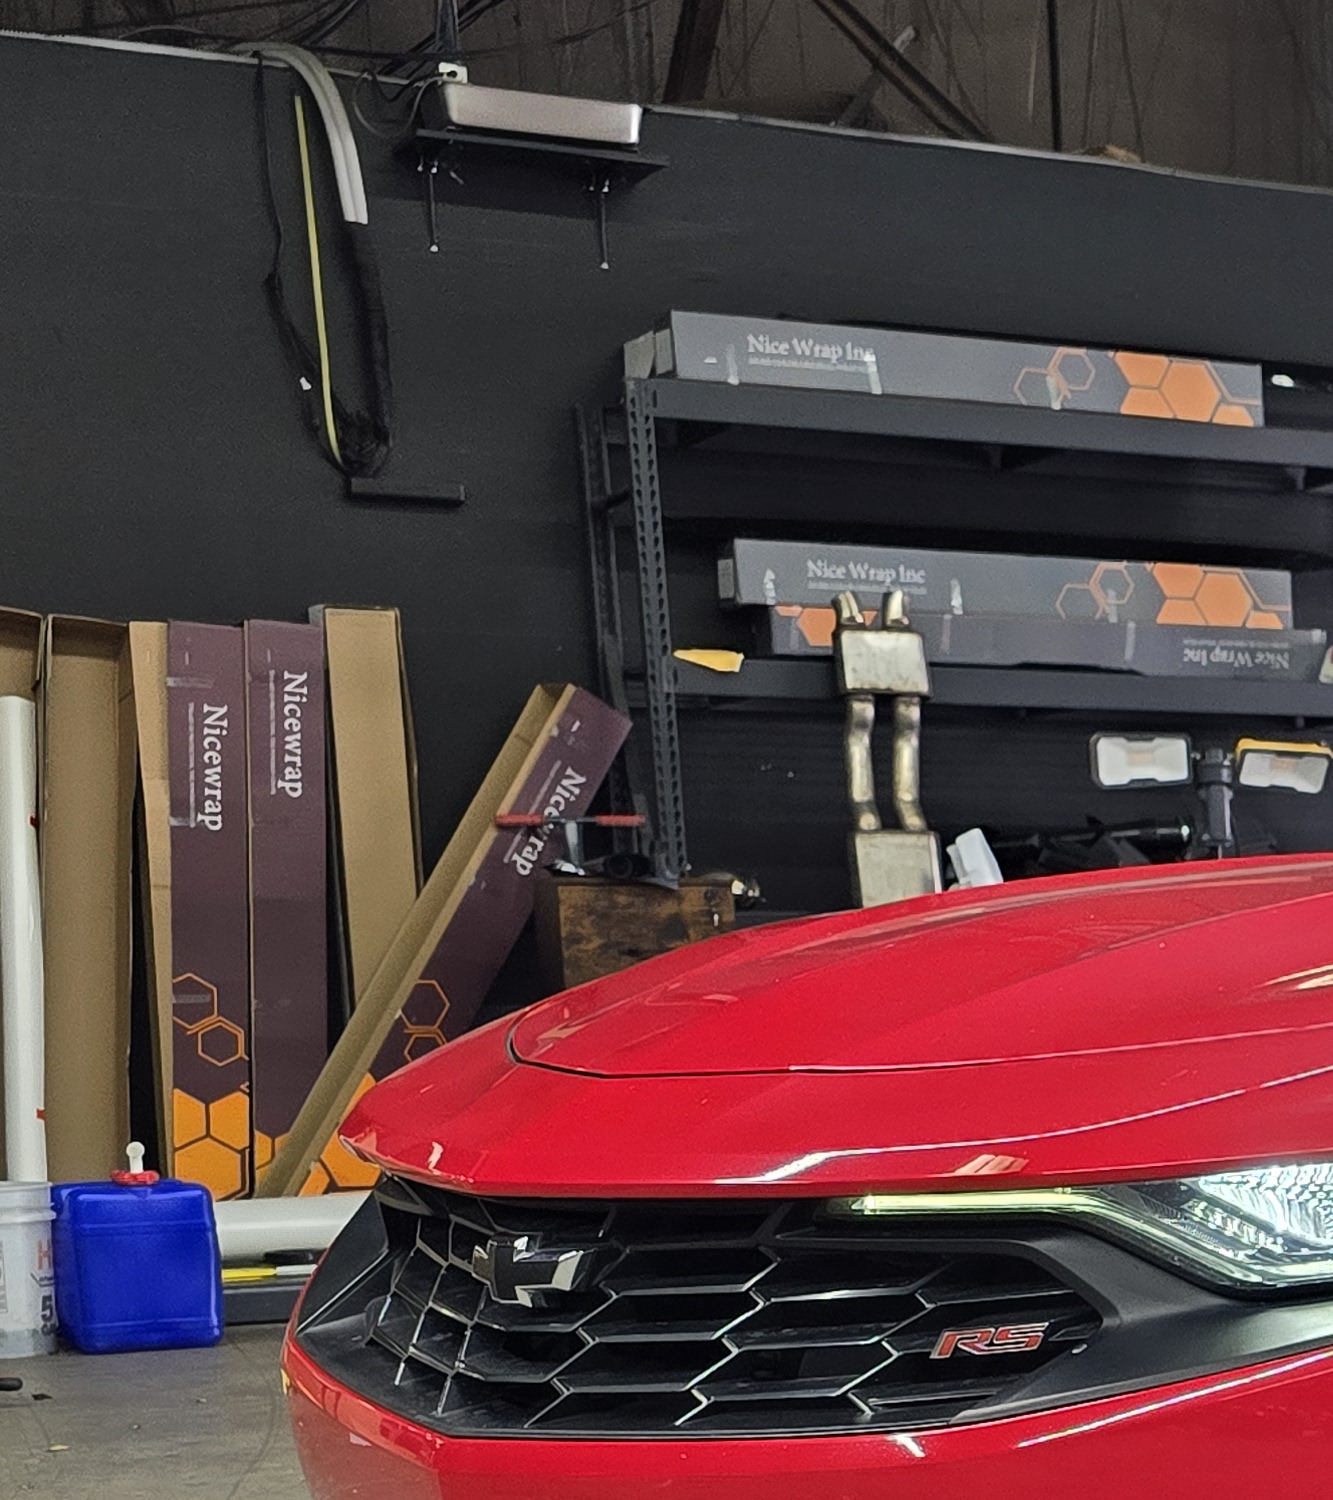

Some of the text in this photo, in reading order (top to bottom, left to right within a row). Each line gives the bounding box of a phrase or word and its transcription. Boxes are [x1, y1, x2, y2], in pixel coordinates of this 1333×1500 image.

[747, 333, 790, 355] Nice
[791, 337, 843, 363] Wrap
[806, 558, 926, 587] Nice Wrap Inc
[1182, 645, 1289, 670] Nice Wrap Inc
[277, 670, 308, 798] Nicewrap
[196, 702, 228, 831] Nicewrap
[929, 1322, 1050, 1359] RS
